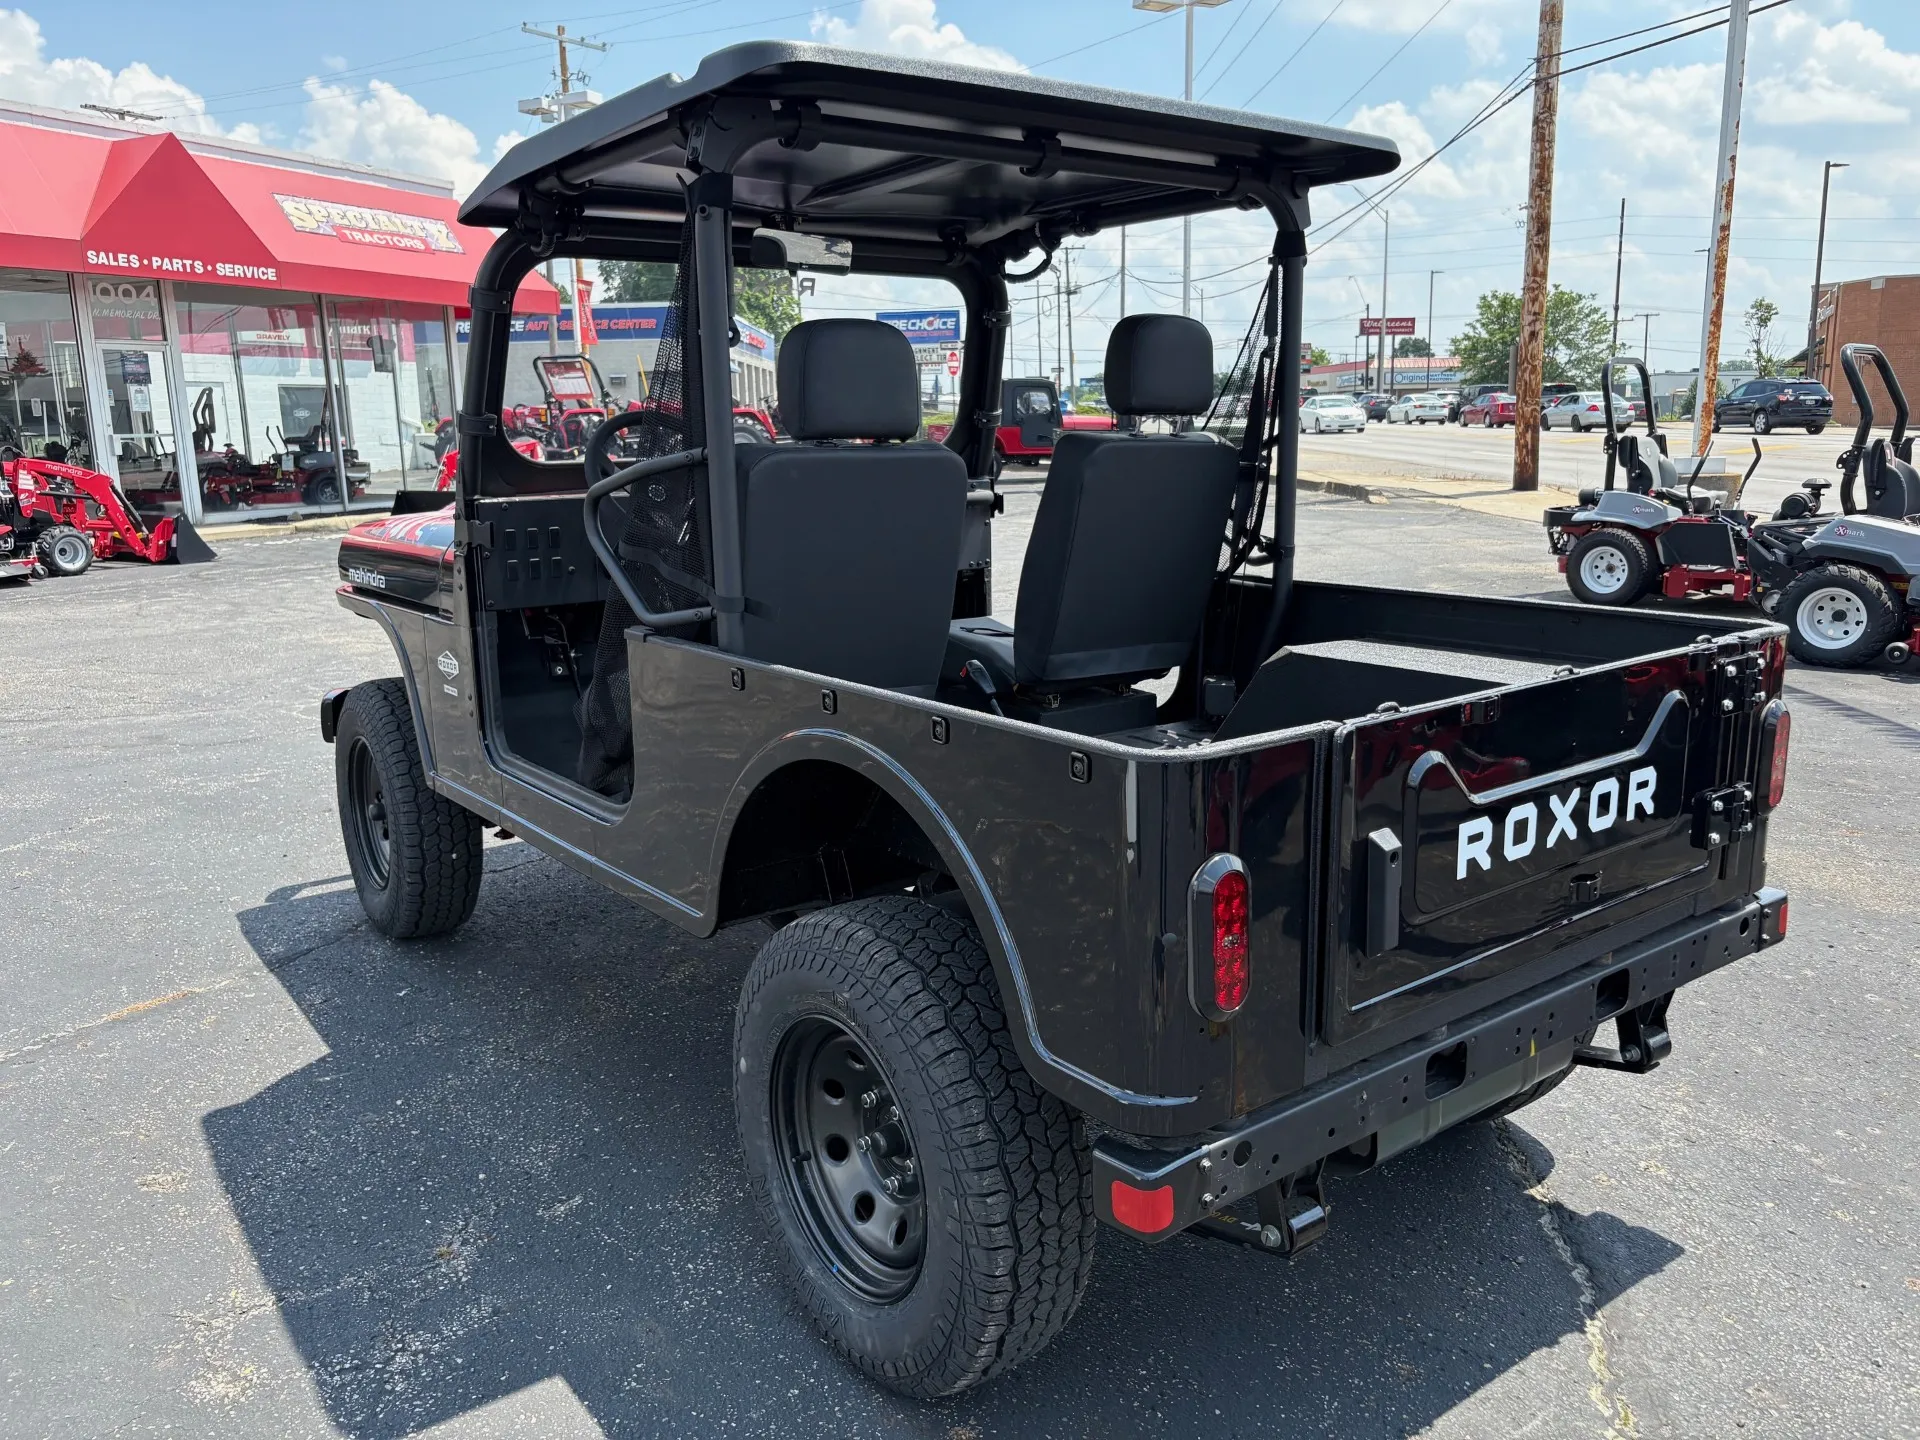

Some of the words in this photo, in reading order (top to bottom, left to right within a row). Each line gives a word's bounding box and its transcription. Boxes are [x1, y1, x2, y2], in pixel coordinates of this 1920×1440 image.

[282, 200, 456, 249] SPECIALTY
[341, 230, 425, 250] TRACTORS
[86, 250, 140, 268] SALES
[152, 256, 204, 274] PARTS
[215, 262, 277, 281] SERVICE
[101, 308, 145, 319] MEMORIAL
[610, 318, 657, 330] CENTER
[256, 332, 292, 341] GRAVELY
[45, 463, 83, 476] mahindra
[348, 567, 386, 589] mahindra
[438, 658, 459, 674] ROXOR
[1457, 766, 1658, 881] ROXOR
